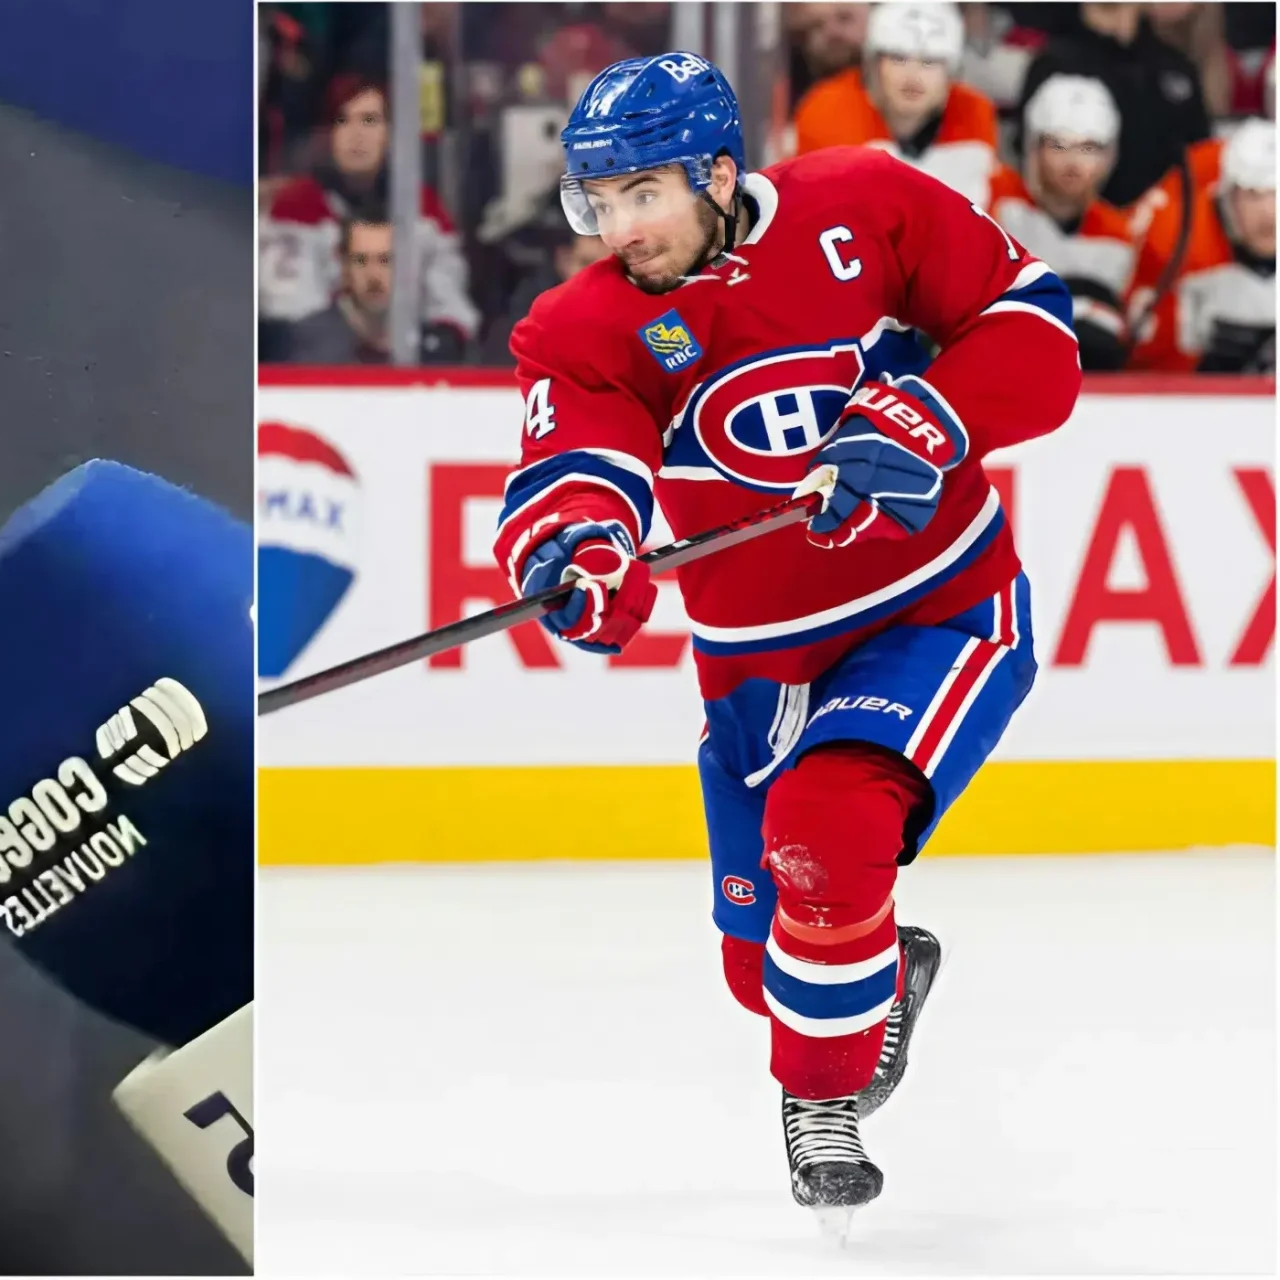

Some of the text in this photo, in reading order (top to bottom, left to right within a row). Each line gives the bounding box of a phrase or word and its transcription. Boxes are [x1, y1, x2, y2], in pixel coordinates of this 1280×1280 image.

[819, 224, 863, 282] C
[664, 344, 698, 370] RBC
[844, 386, 946, 456] UER
[805, 695, 914, 731] AUER
